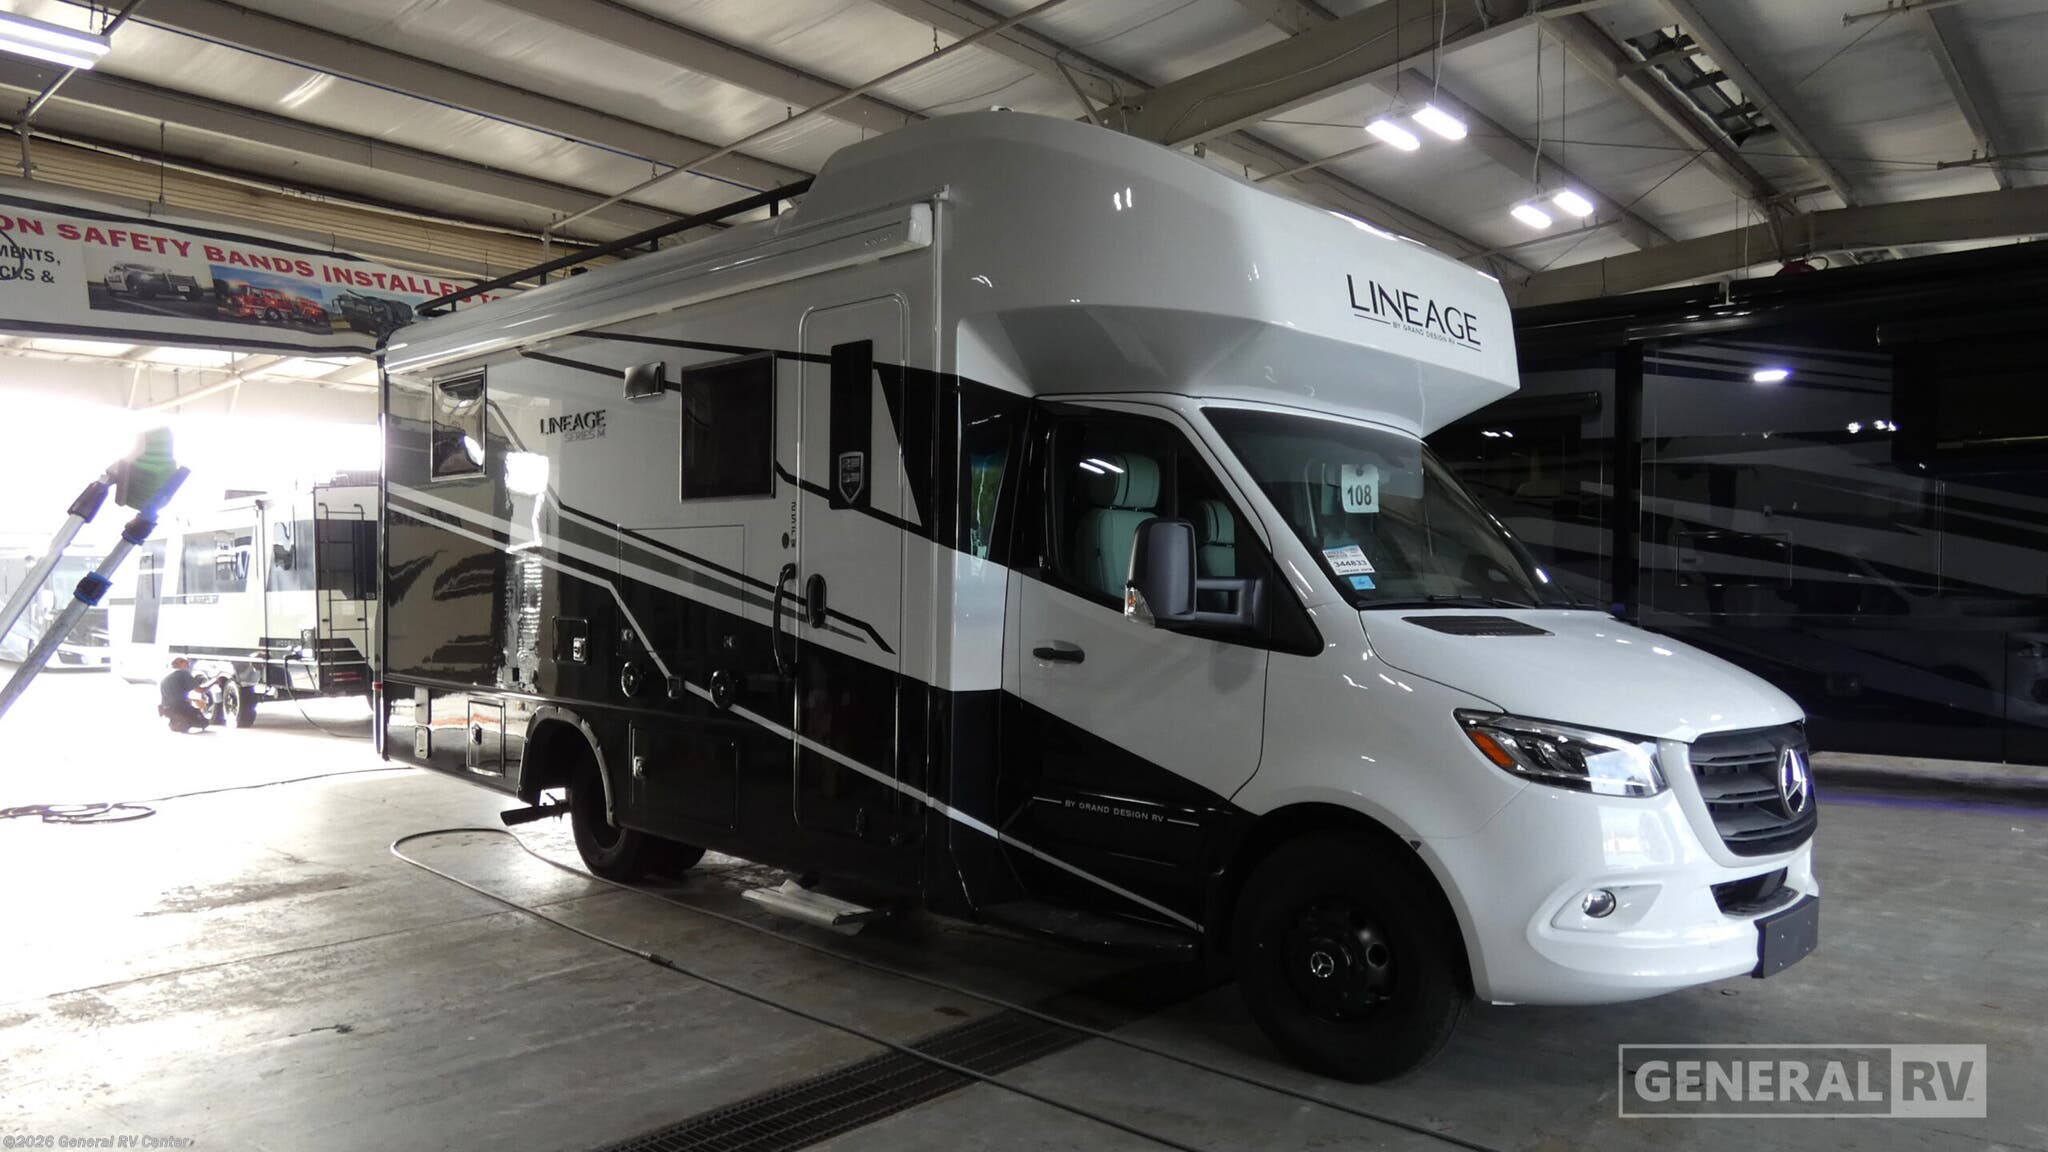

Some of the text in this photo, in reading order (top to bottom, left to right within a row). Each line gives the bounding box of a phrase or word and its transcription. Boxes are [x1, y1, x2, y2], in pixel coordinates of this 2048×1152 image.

[56, 223, 192, 258] SAFETY
[203, 244, 315, 277] BANDS
[41, 270, 55, 284] &
[1346, 273, 1482, 346] LINEAGE
[1403, 324, 1425, 336] GRAND
[1426, 330, 1448, 343] DESIGN
[540, 409, 607, 435] LINEAGE
[1346, 484, 1373, 506] 108
[1065, 799, 1165, 823] BY GRAND DESIGN RV
